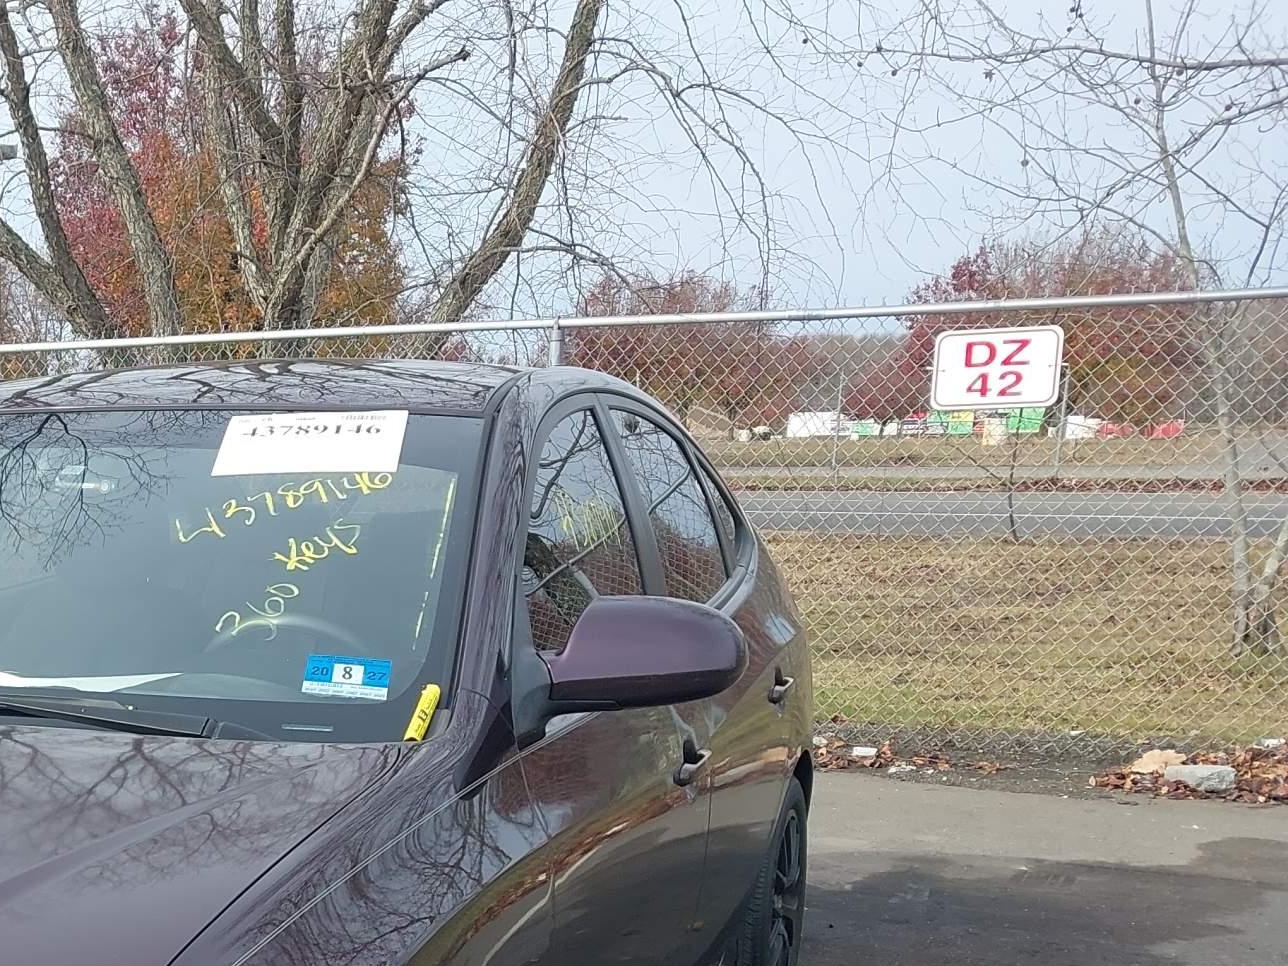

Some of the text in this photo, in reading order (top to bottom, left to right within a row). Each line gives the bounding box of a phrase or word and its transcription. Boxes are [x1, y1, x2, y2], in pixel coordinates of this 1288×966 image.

[964, 338, 1032, 368] DZ
[966, 370, 1024, 398] 42
[241, 424, 381, 437] 43789146
[175, 471, 393, 543] 43789146
[311, 666, 387, 681] 20 8 27
